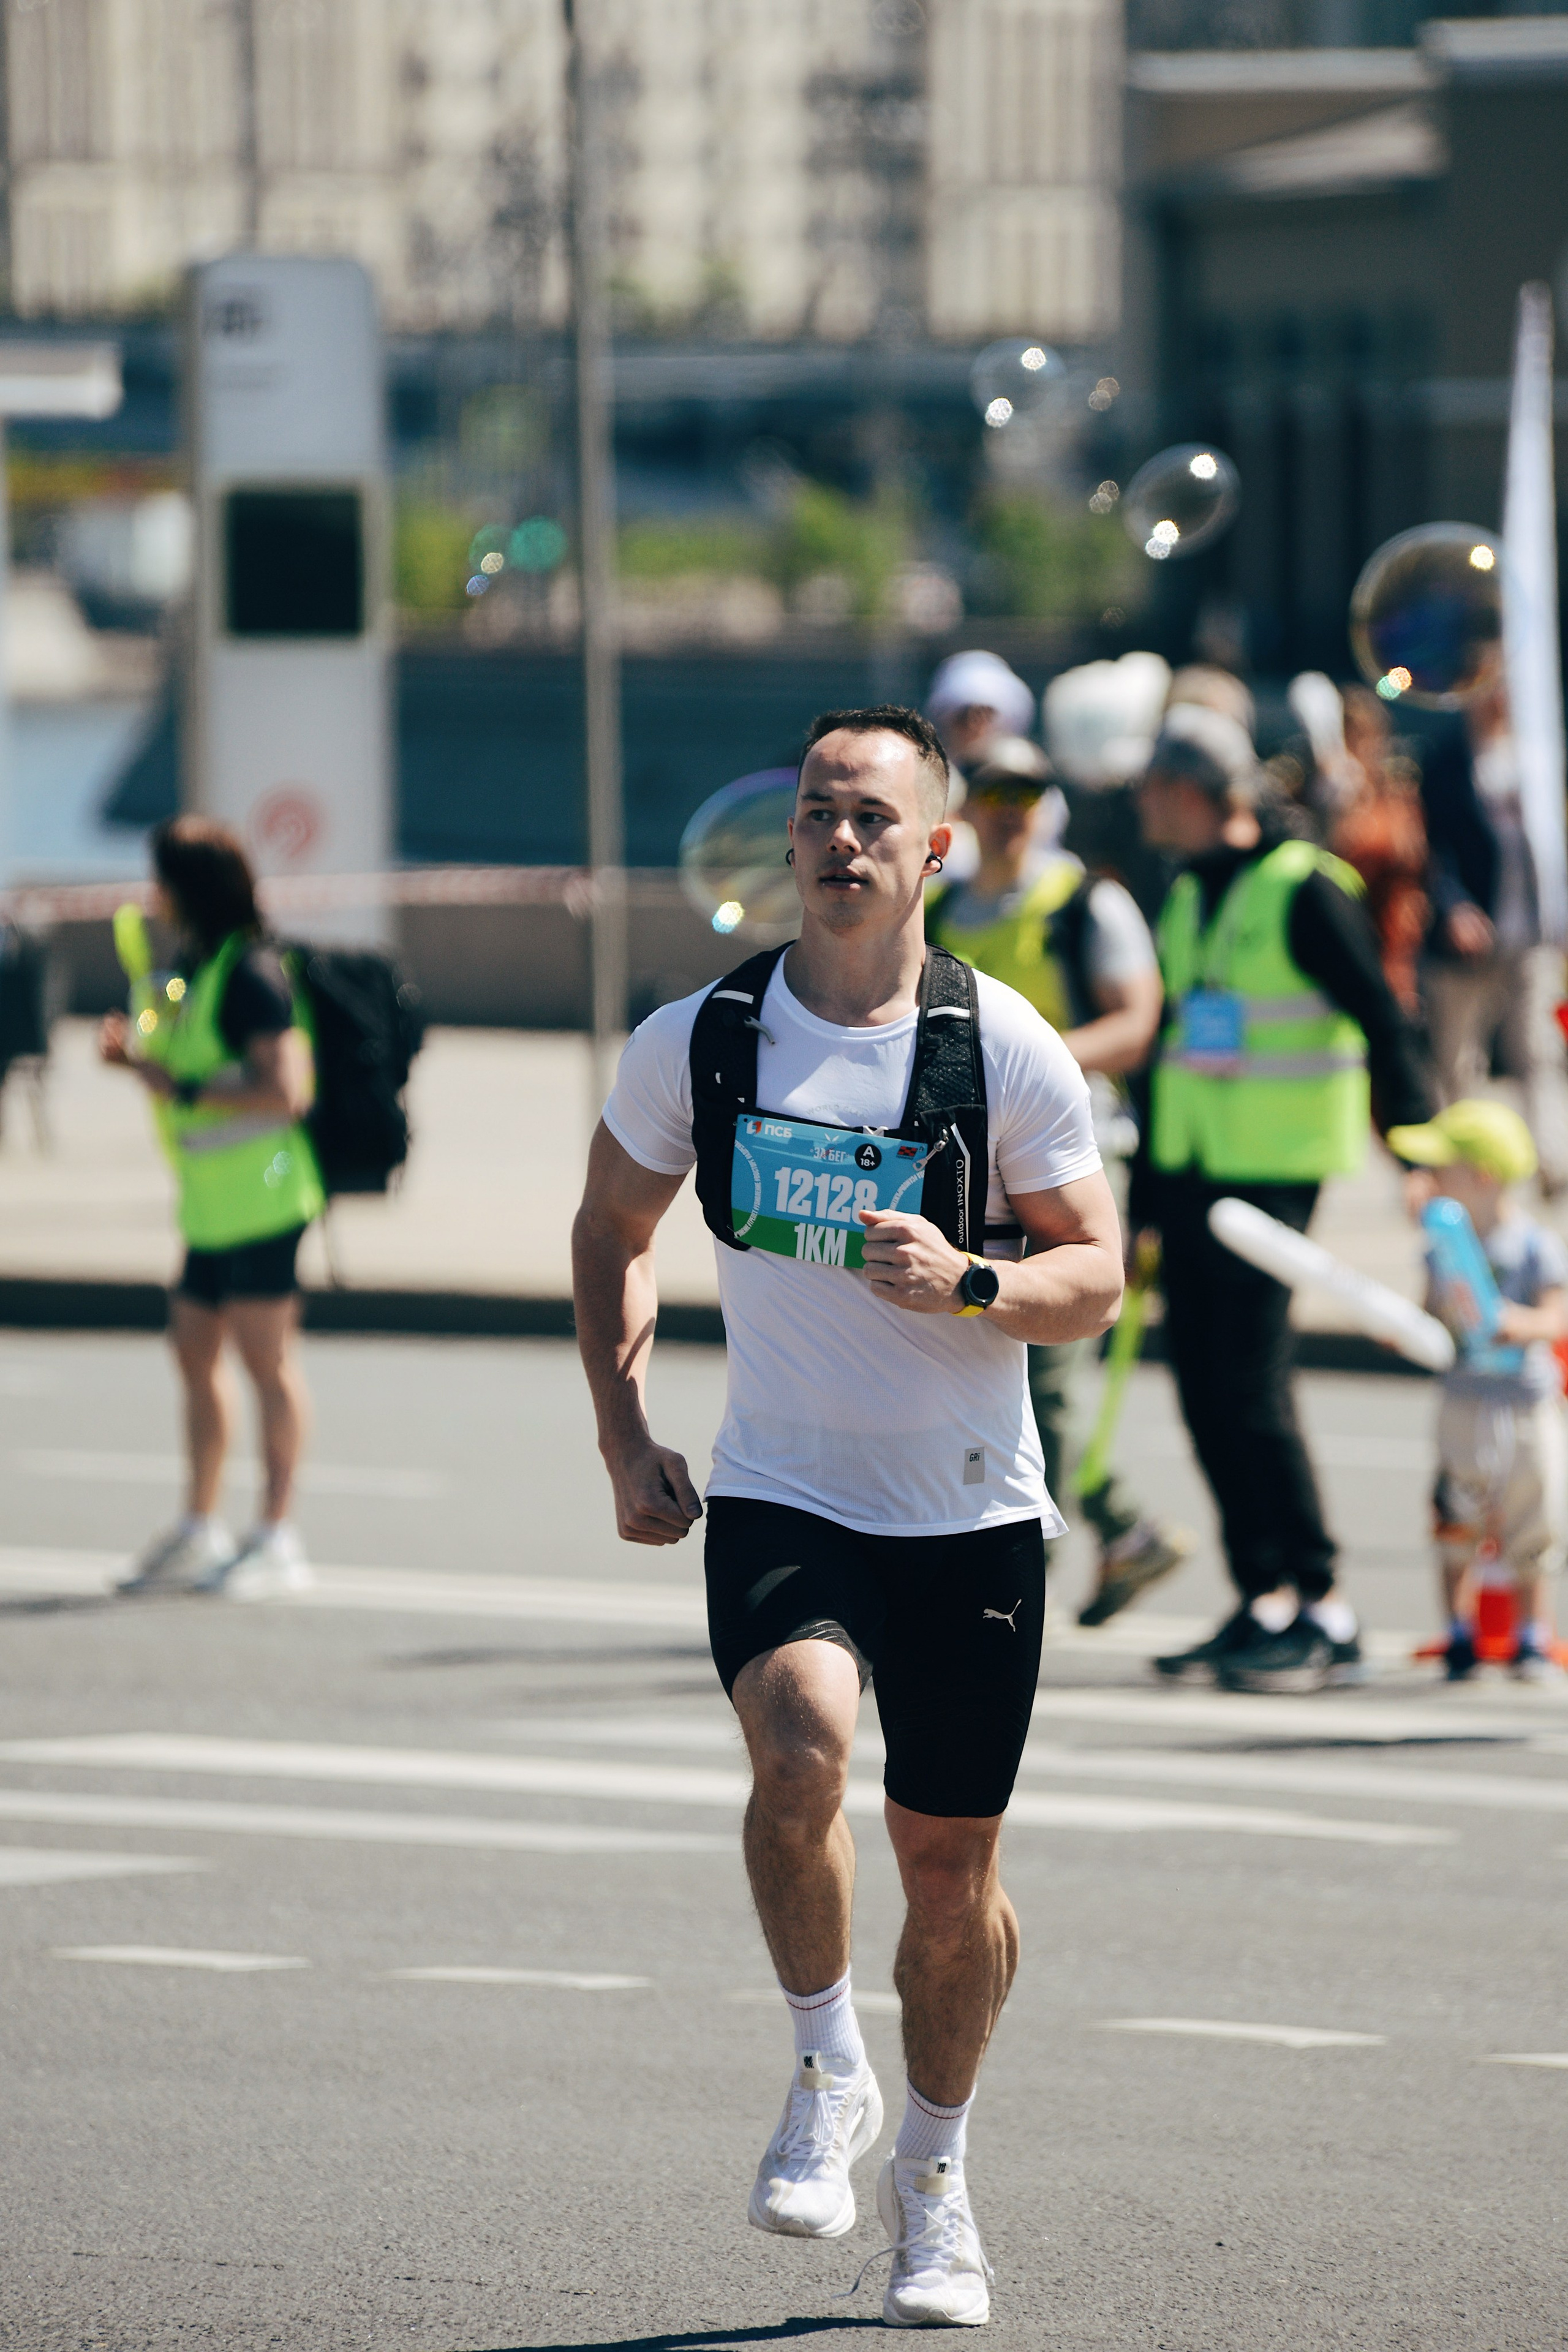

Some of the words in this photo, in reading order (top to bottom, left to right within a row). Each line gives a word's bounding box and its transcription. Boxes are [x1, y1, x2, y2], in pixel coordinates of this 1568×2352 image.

[806, 1104, 839, 1115] WORLD
[764, 1124, 793, 1138] ПСБ
[862, 1146, 875, 1158] A
[860, 1158, 875, 1166] 18+
[956, 1159, 964, 1206] INOXTO
[774, 1167, 878, 1226] 12128
